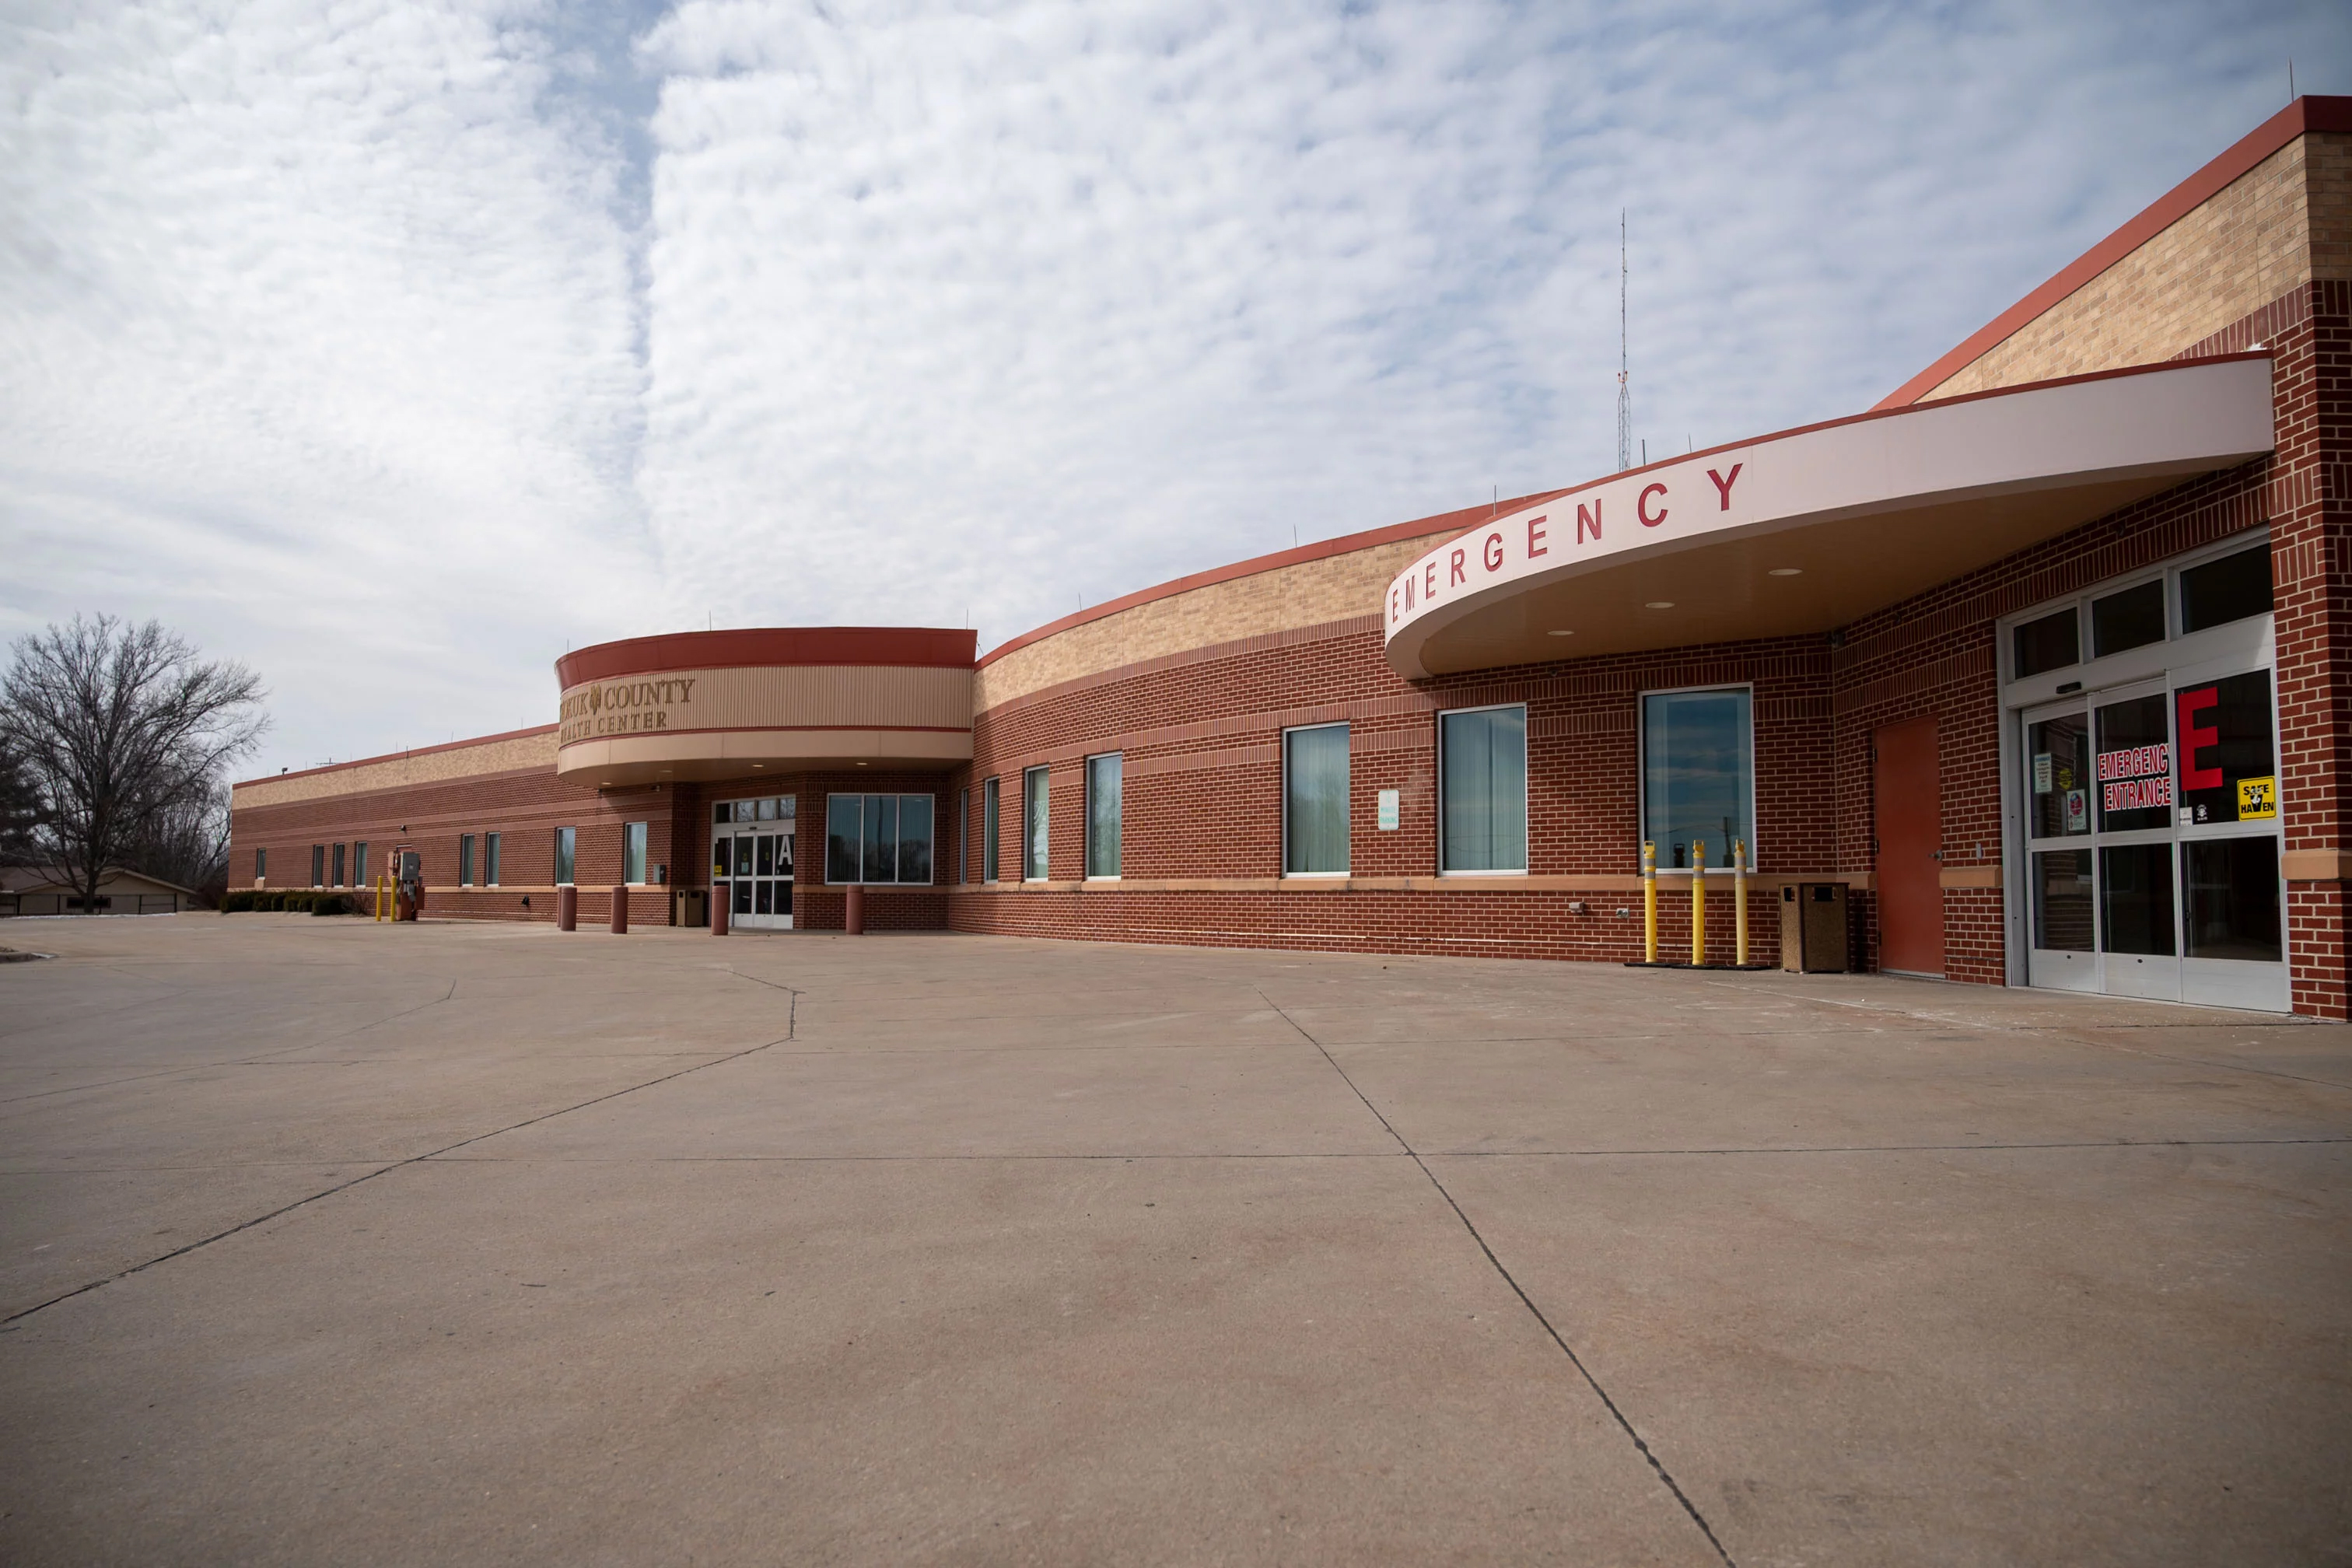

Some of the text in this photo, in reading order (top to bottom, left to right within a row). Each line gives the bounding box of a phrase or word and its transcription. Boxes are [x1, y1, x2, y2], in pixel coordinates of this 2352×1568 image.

[1392, 463, 1743, 623] EMERGENCY
[605, 679, 695, 710] COUNTY
[598, 711, 667, 733] CENTER
[2178, 686, 2223, 791] E
[2098, 744, 2169, 781] EMERGENC
[2104, 776, 2171, 811] ENTRANCE
[2241, 794, 2274, 814] HAVEN
[2243, 784, 2270, 796] SAFE
[778, 835, 793, 866] A
